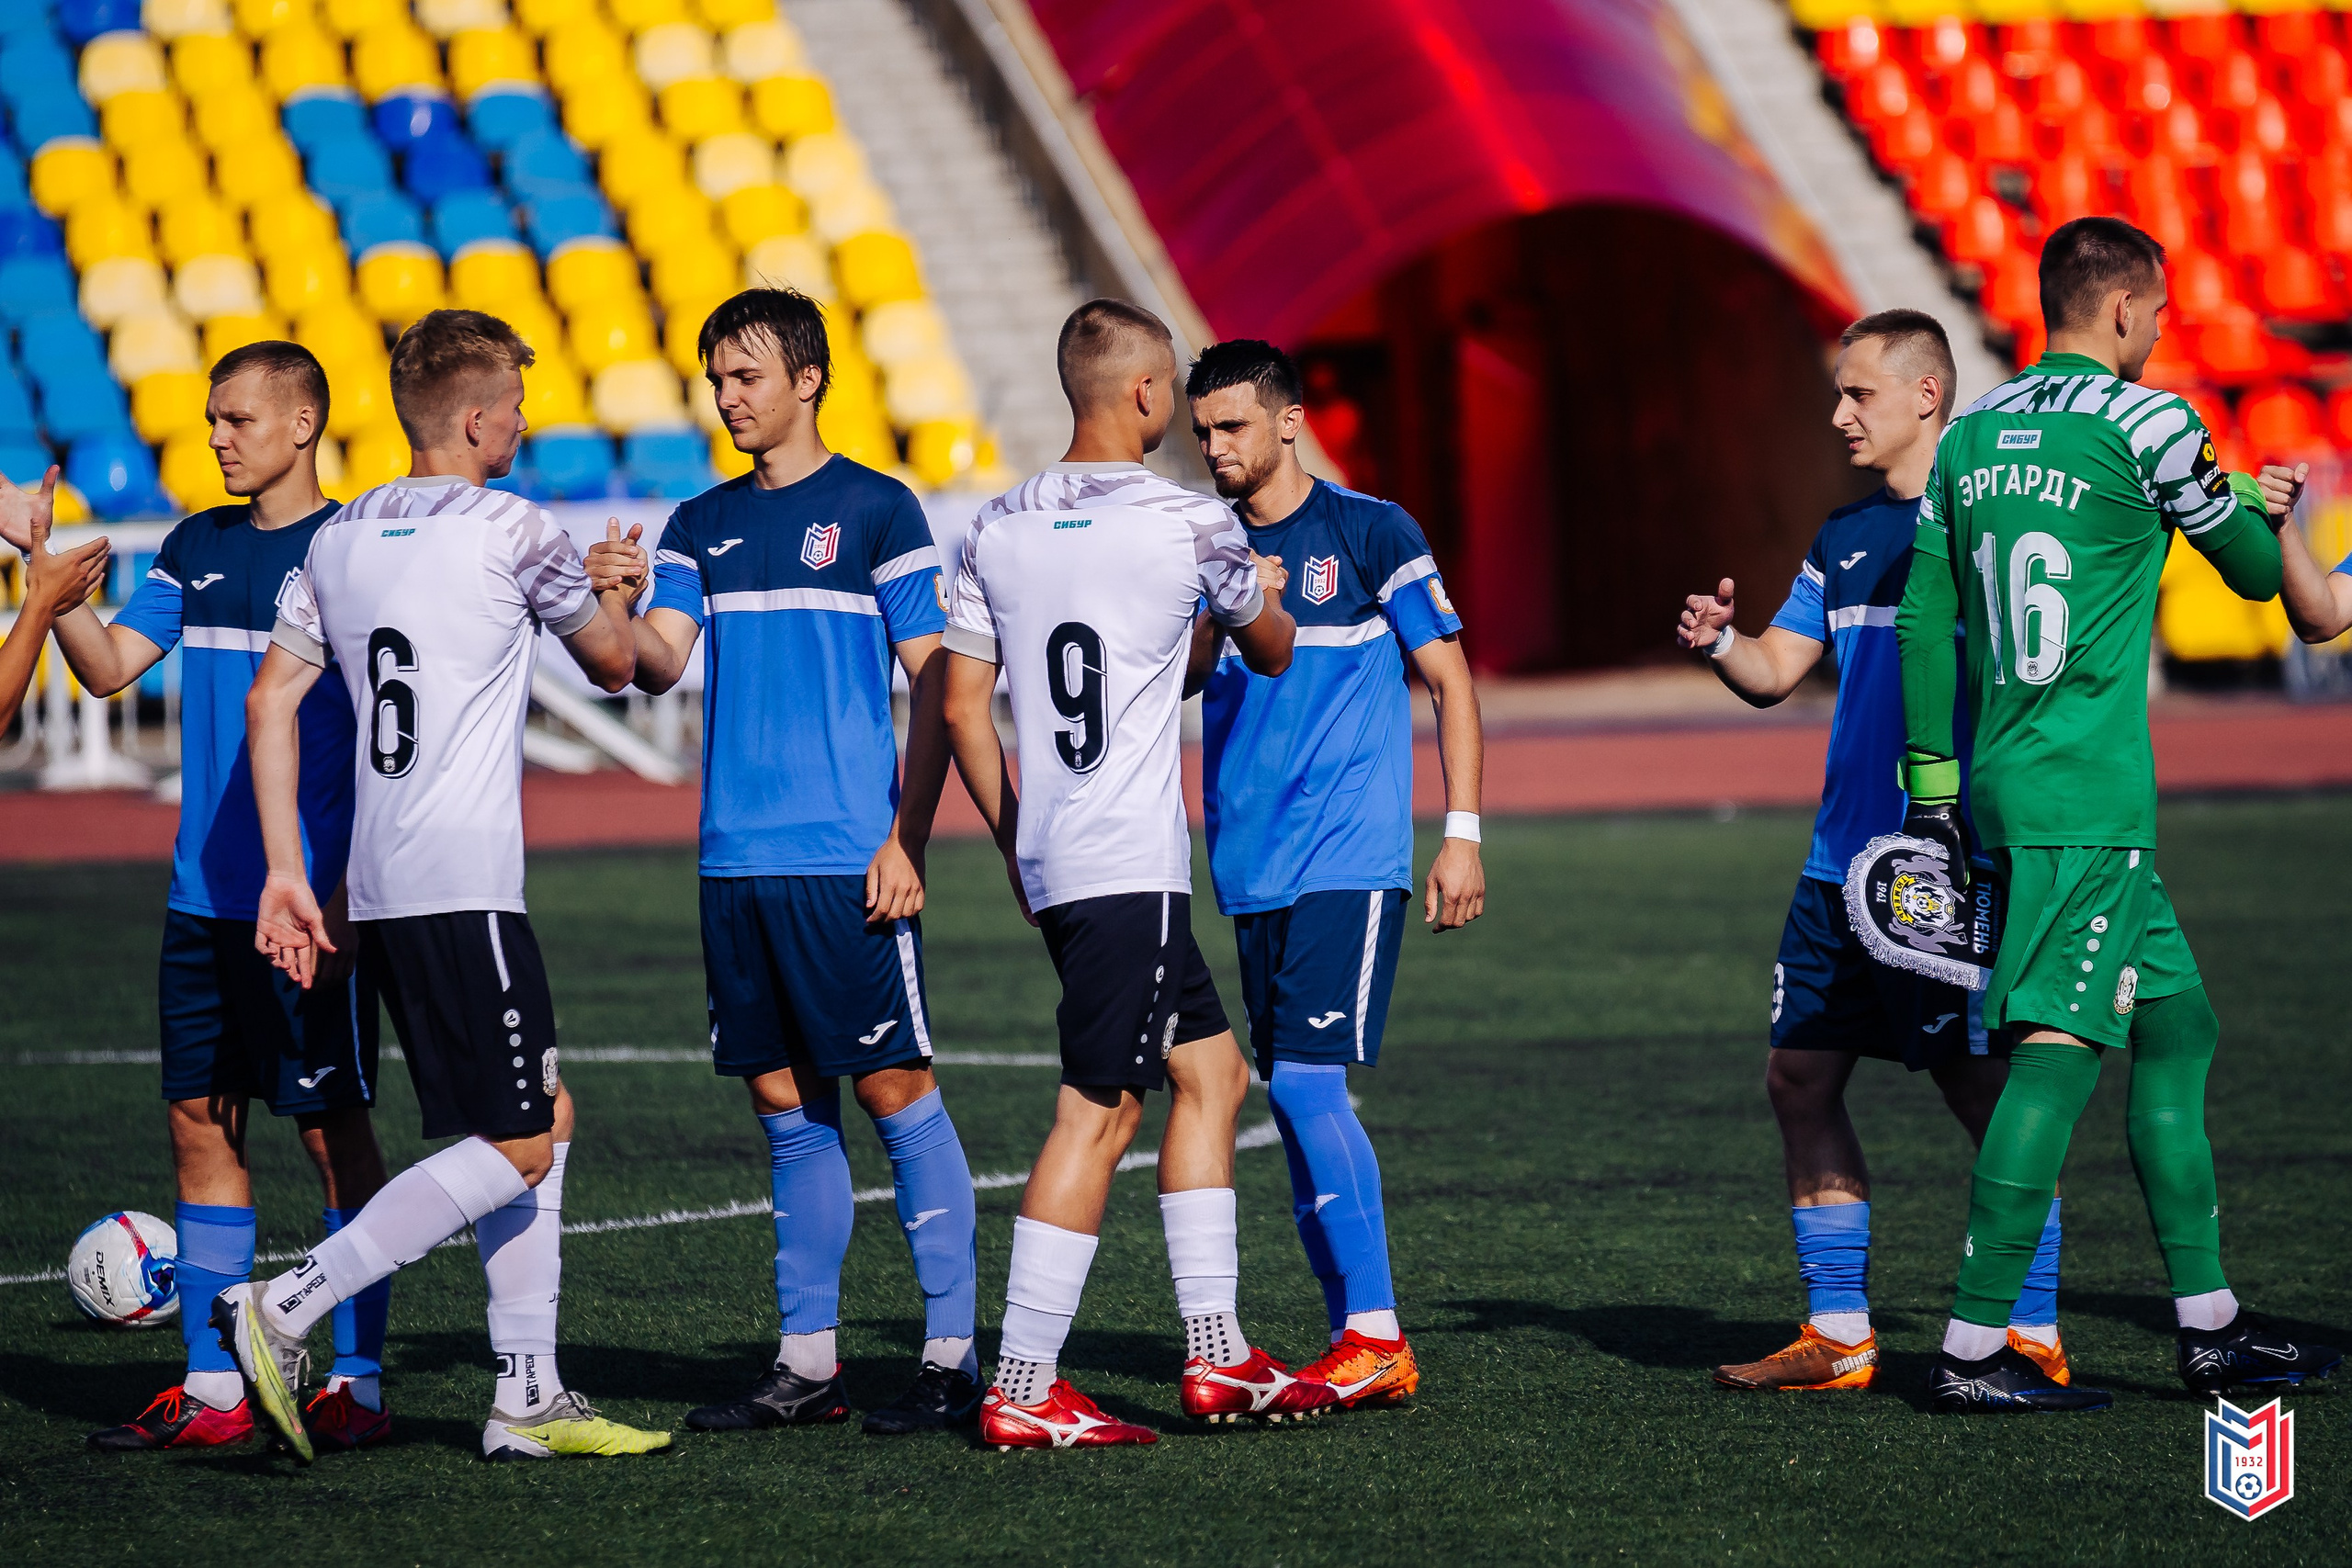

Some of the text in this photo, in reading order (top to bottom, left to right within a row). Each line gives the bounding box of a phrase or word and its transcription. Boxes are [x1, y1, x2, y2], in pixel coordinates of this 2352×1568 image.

[2002, 434, 2038, 445] СИБУР
[1959, 463, 2091, 511] ЭРГАРДТ
[381, 528, 416, 537] СИБУР
[1054, 519, 1092, 529] СИБУР
[1973, 531, 2072, 685] 16
[368, 626, 419, 779] 6
[1046, 621, 1109, 774] 9
[1876, 881, 1887, 904] 1961
[1973, 882, 1992, 954] ТЮМЕНЬ
[96, 1250, 116, 1307] DEMIX
